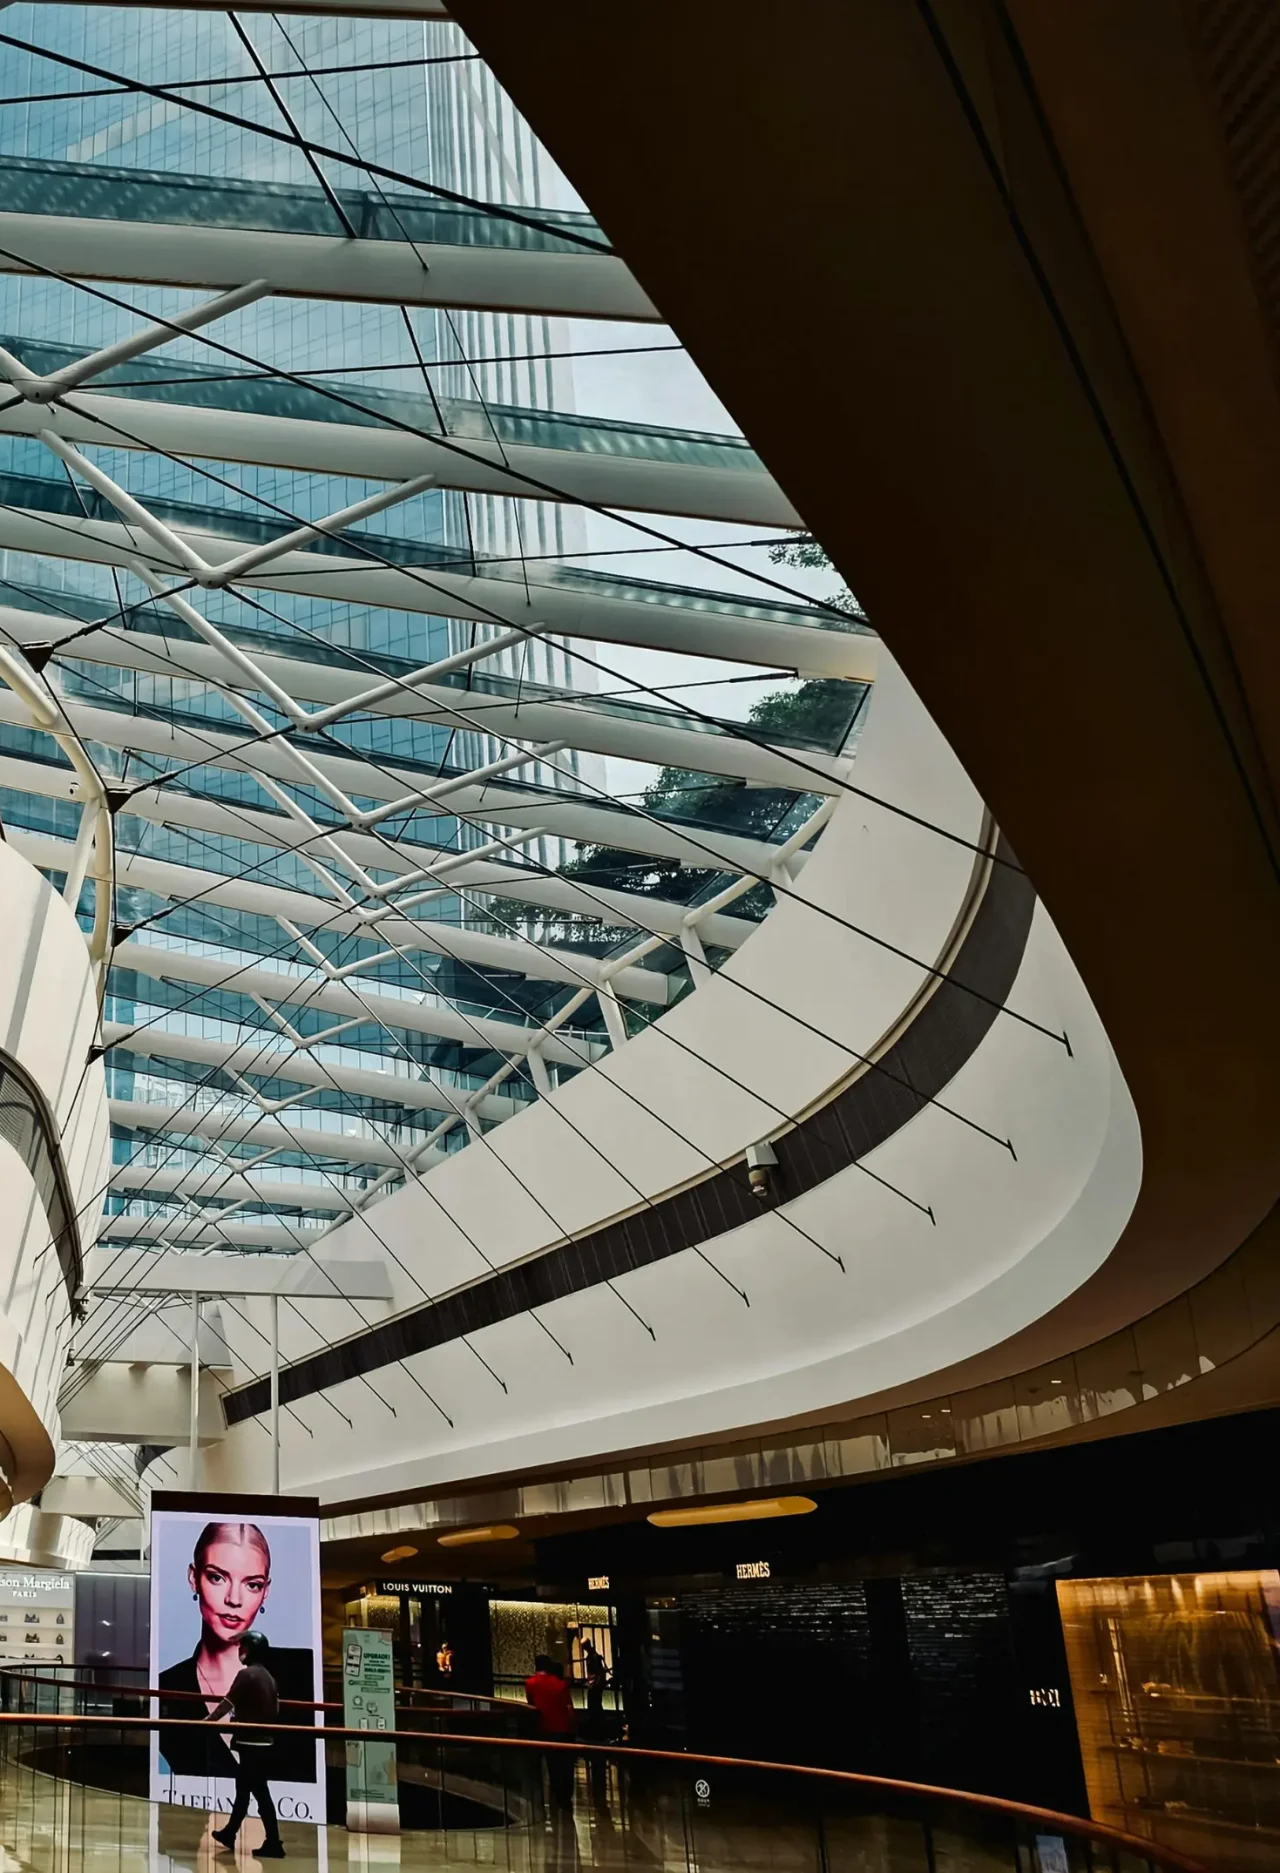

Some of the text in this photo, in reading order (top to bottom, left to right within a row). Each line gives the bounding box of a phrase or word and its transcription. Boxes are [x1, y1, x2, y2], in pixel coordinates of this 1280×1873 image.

[23, 1576, 70, 1591] Margiela
[383, 1583, 452, 1594] LOUIS VUITTON
[12, 1590, 37, 1598] PARIS
[277, 1796, 314, 1820] Co.
